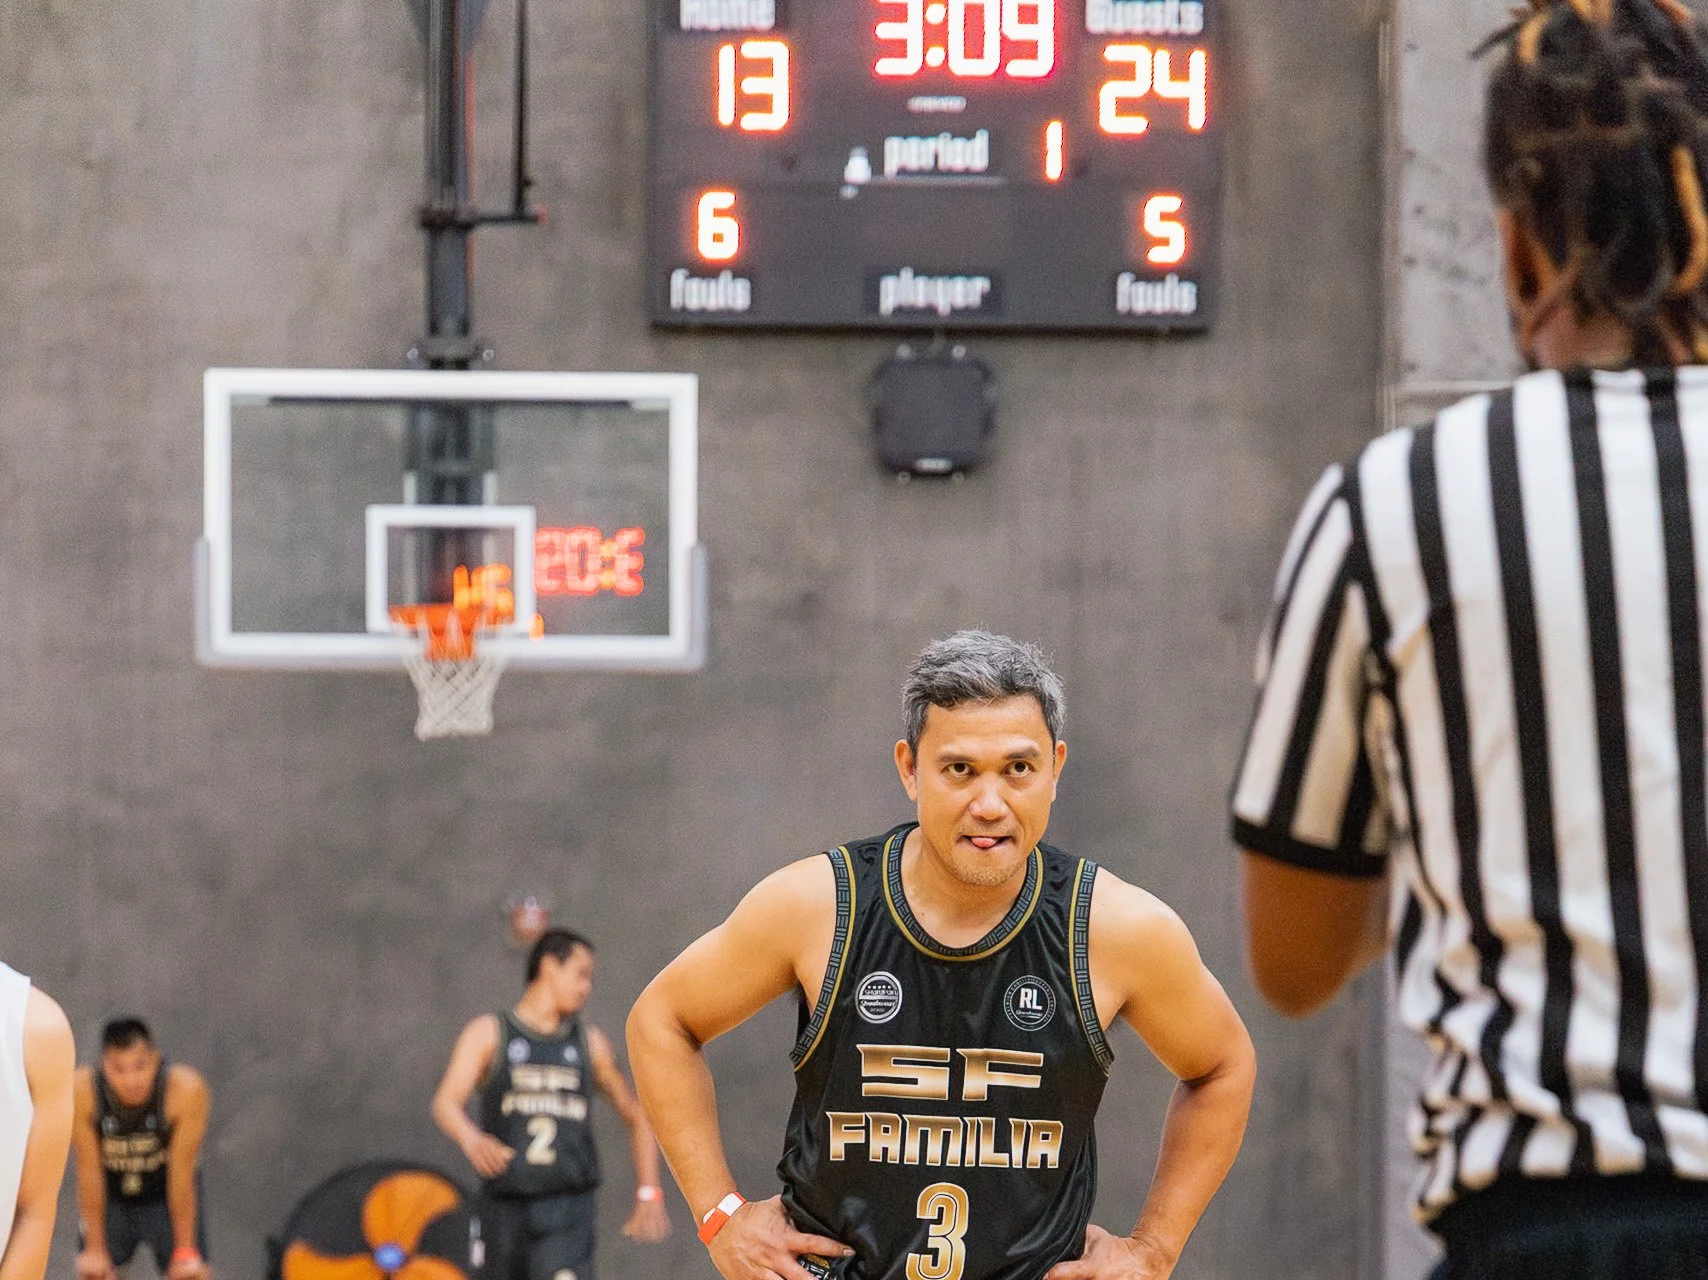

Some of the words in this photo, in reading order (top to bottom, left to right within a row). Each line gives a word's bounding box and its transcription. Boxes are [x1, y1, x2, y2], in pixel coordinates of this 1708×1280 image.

[875, 0, 1056, 77] 3:09
[717, 40, 791, 131] 13
[1099, 44, 1207, 134] 24
[883, 129, 990, 178] period
[1045, 120, 1063, 180] 1
[697, 191, 740, 260] 6
[1143, 195, 1187, 264] 5
[670, 269, 752, 312] fouls
[878, 266, 991, 317] player
[1116, 272, 1198, 316] fouls
[1019, 987, 1043, 1011] RL
[856, 1043, 1045, 1101] SF
[525, 1112, 558, 1166] 2
[825, 1110, 1064, 1169] FAMILIA
